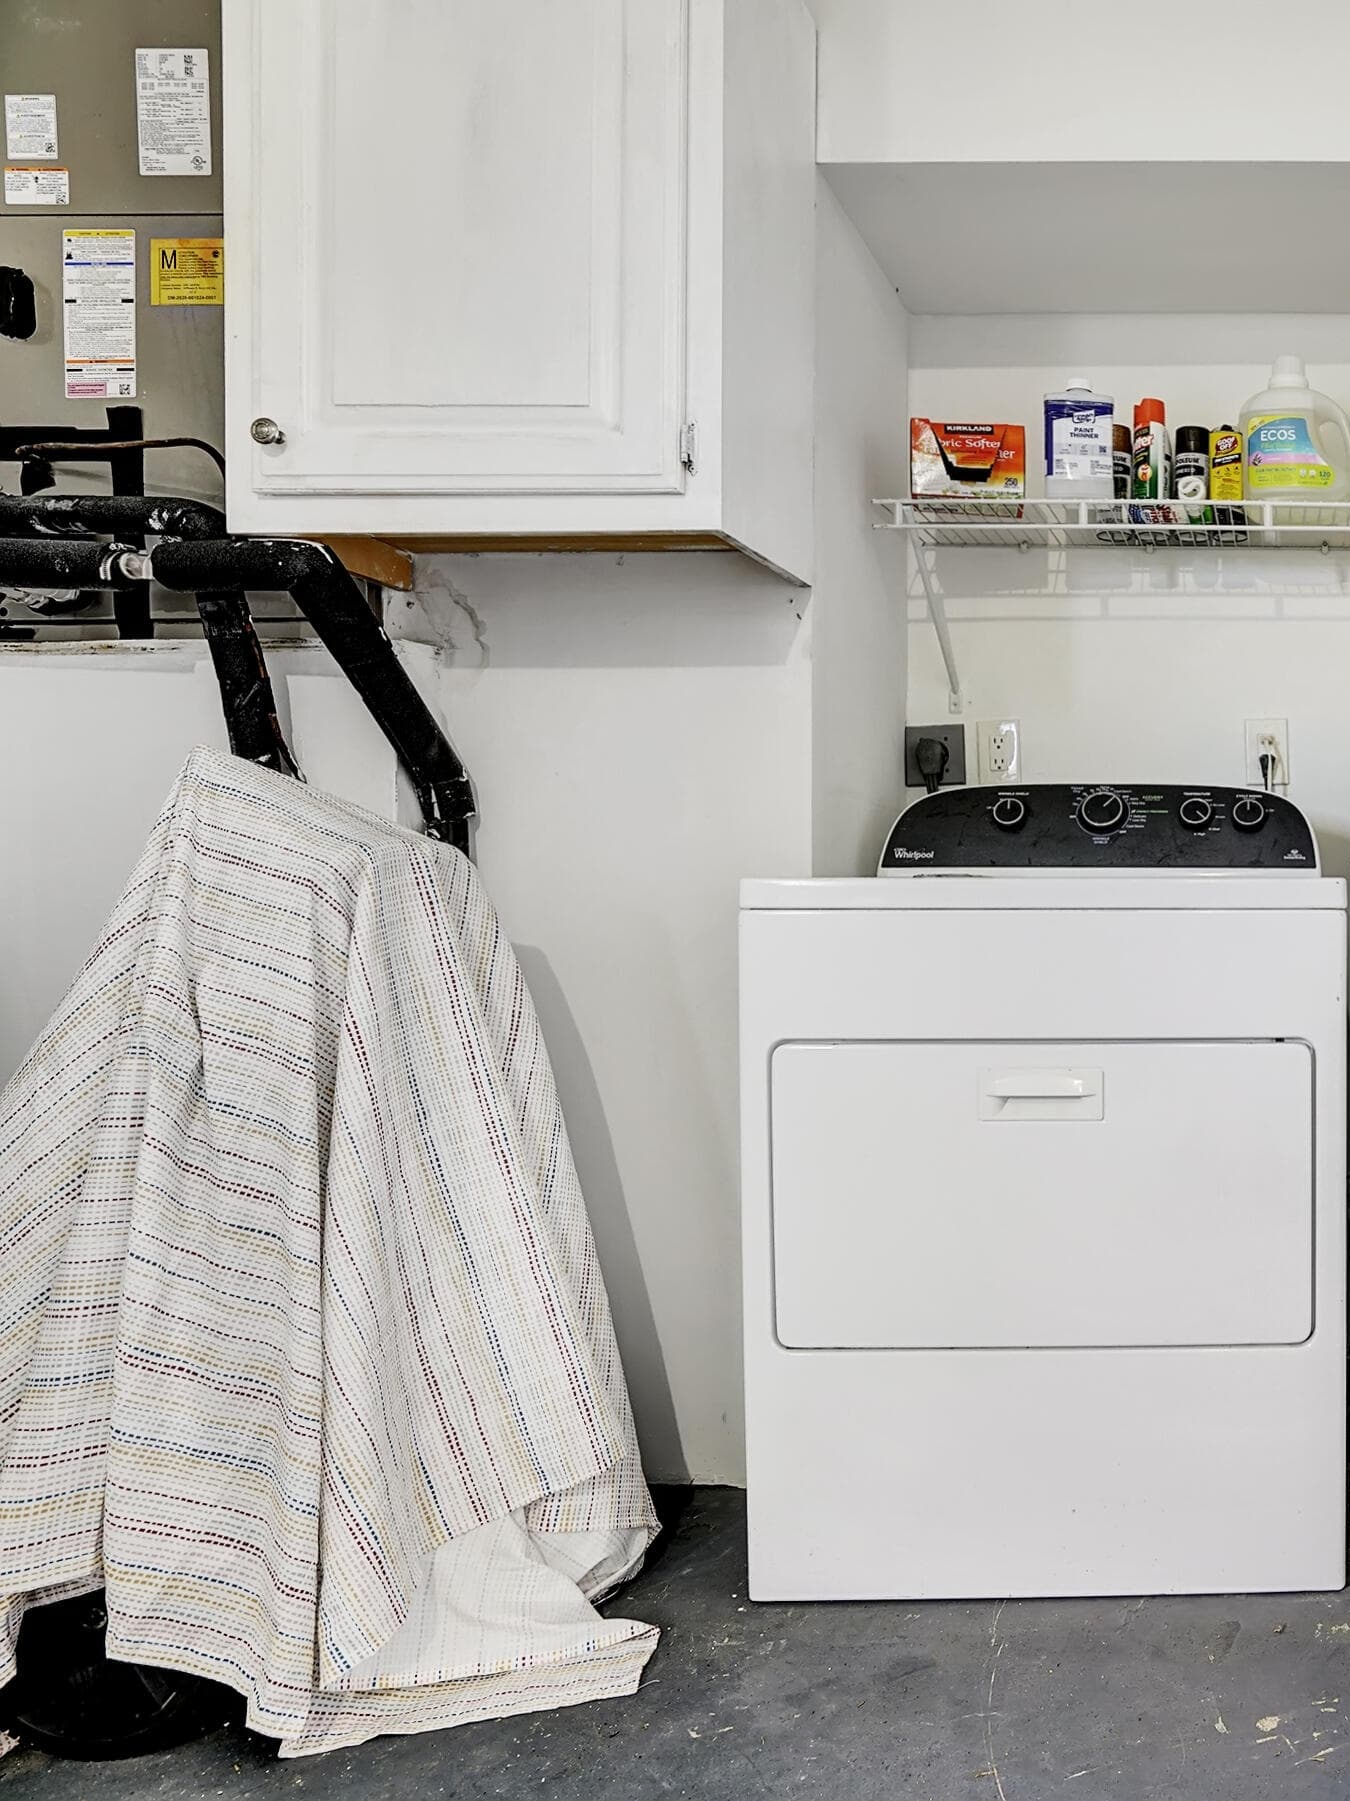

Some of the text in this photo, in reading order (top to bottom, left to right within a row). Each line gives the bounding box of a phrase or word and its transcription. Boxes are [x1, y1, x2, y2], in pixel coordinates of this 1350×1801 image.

[161, 249, 177, 270] M
[1260, 429, 1296, 441] ECOS
[1004, 477, 1018, 486] 250
[894, 848, 934, 860] Whirlpool
